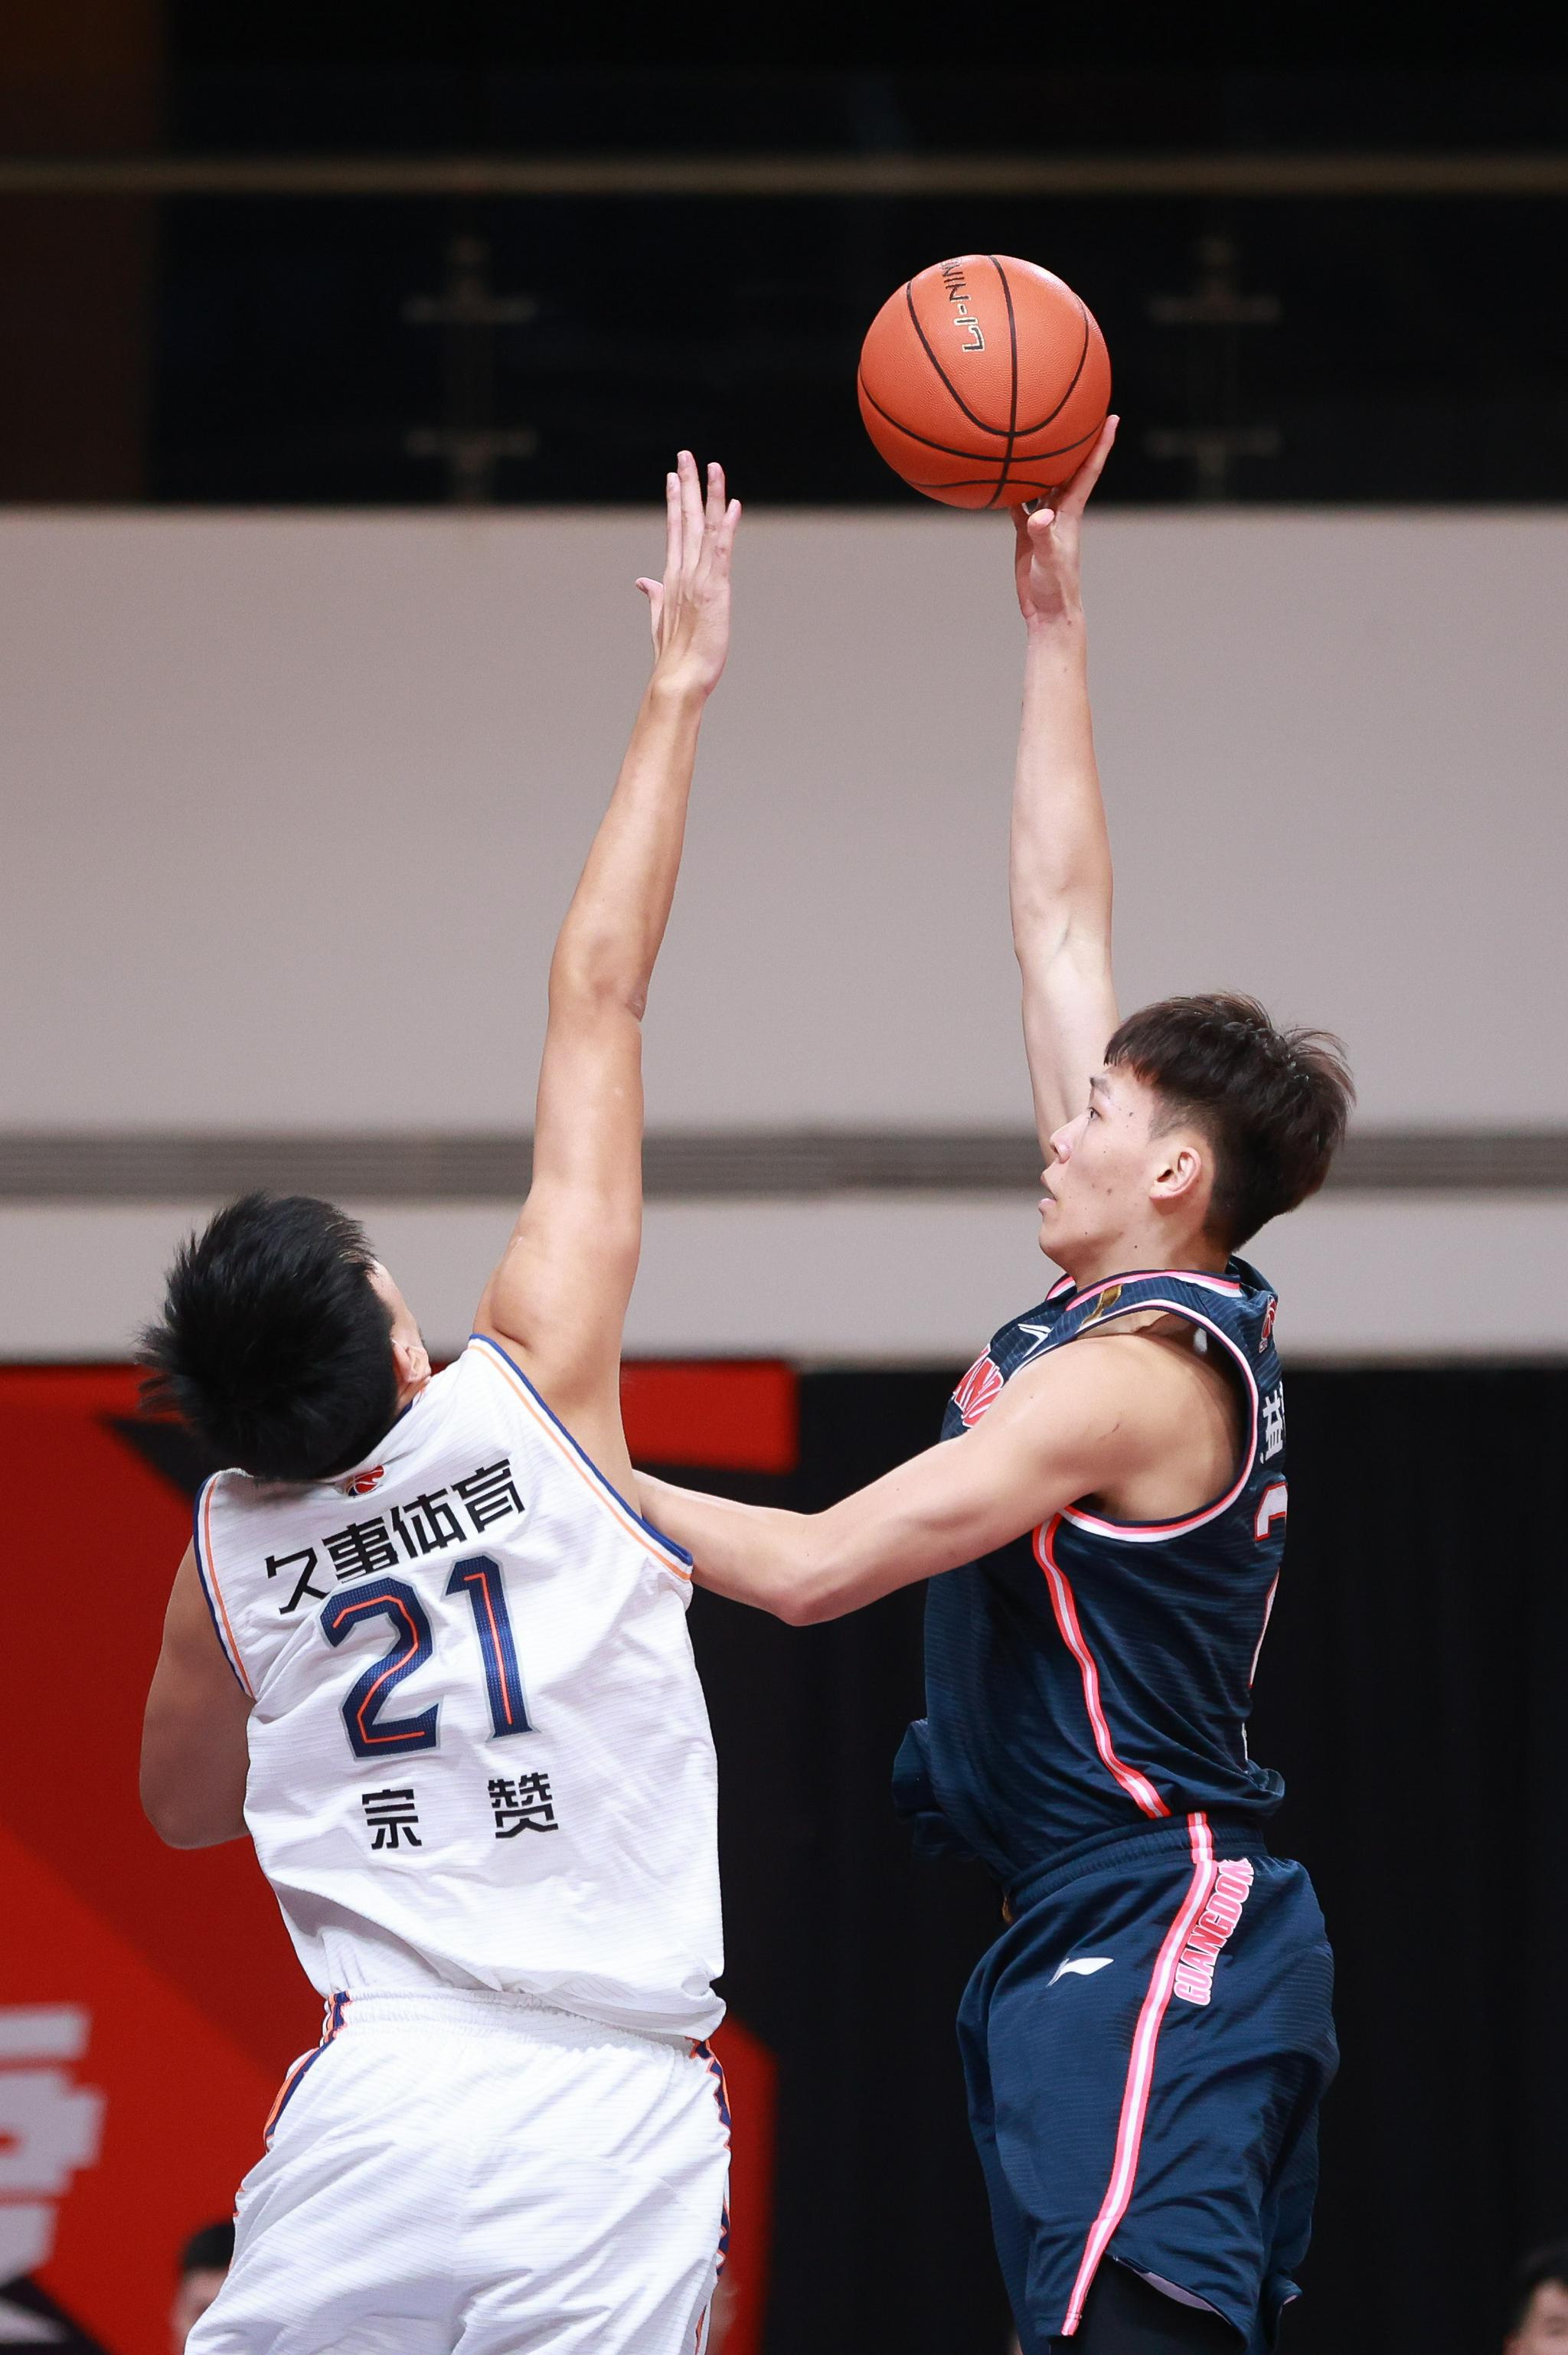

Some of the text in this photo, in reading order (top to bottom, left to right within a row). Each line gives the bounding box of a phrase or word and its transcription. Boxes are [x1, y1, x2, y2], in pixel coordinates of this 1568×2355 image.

[265, 1458, 525, 1615] 久事体育
[315, 1553, 542, 1762] 21
